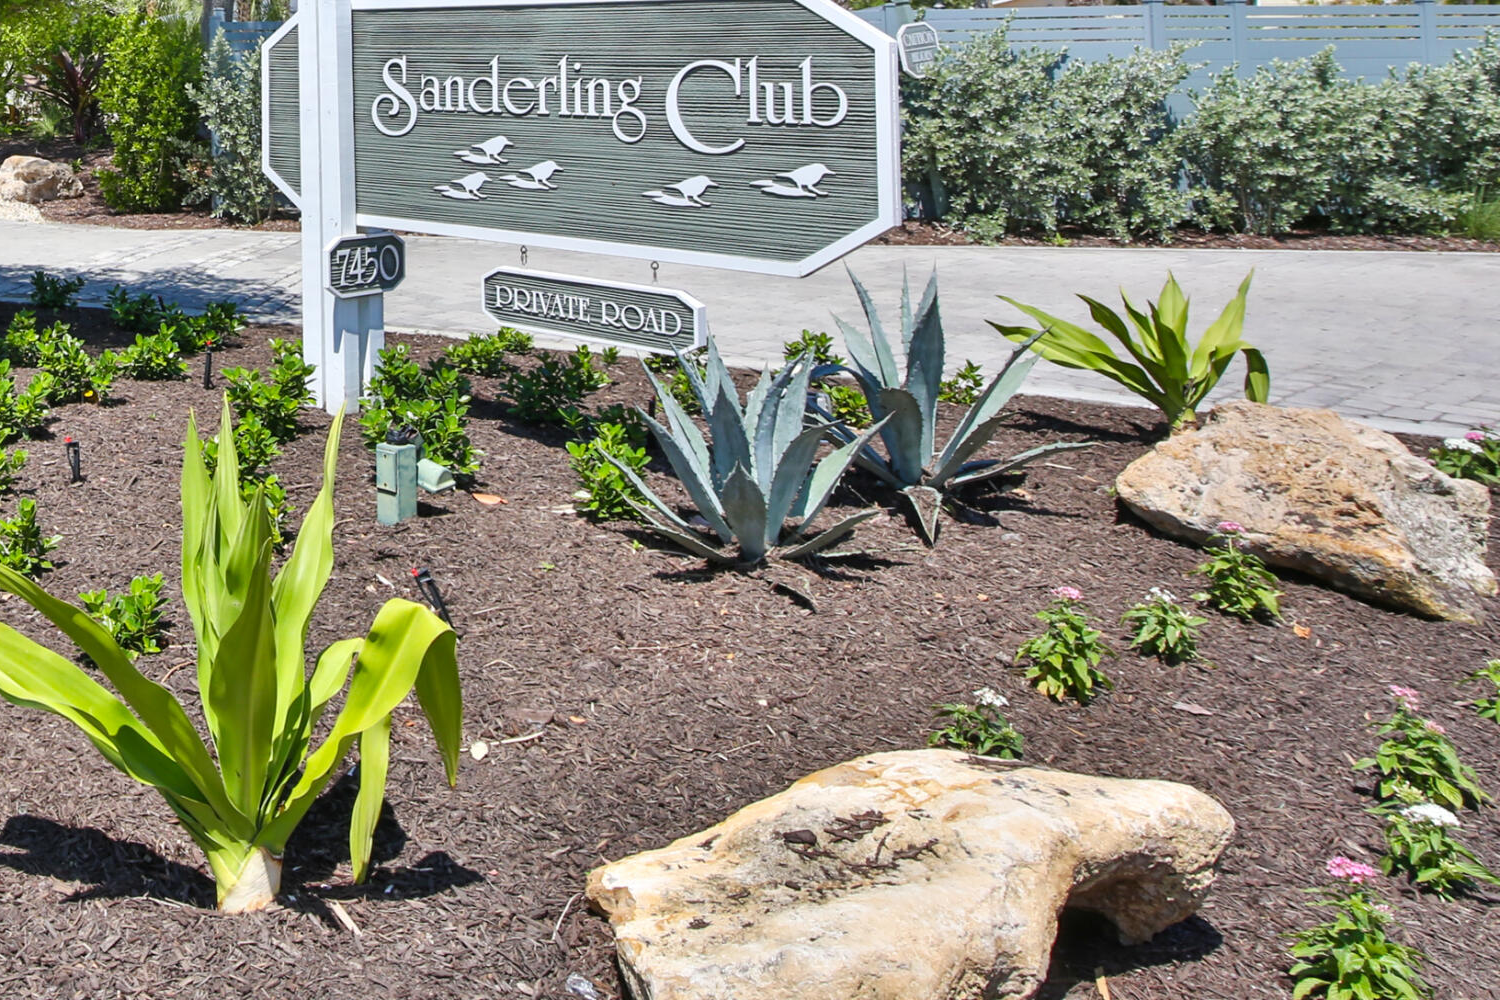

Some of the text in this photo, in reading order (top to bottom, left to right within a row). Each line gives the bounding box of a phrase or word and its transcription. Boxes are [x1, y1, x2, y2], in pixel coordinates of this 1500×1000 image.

[371, 54, 848, 155] Sanderling Club
[336, 244, 400, 287] 7450
[495, 285, 683, 337] PRIVATE ROAD
